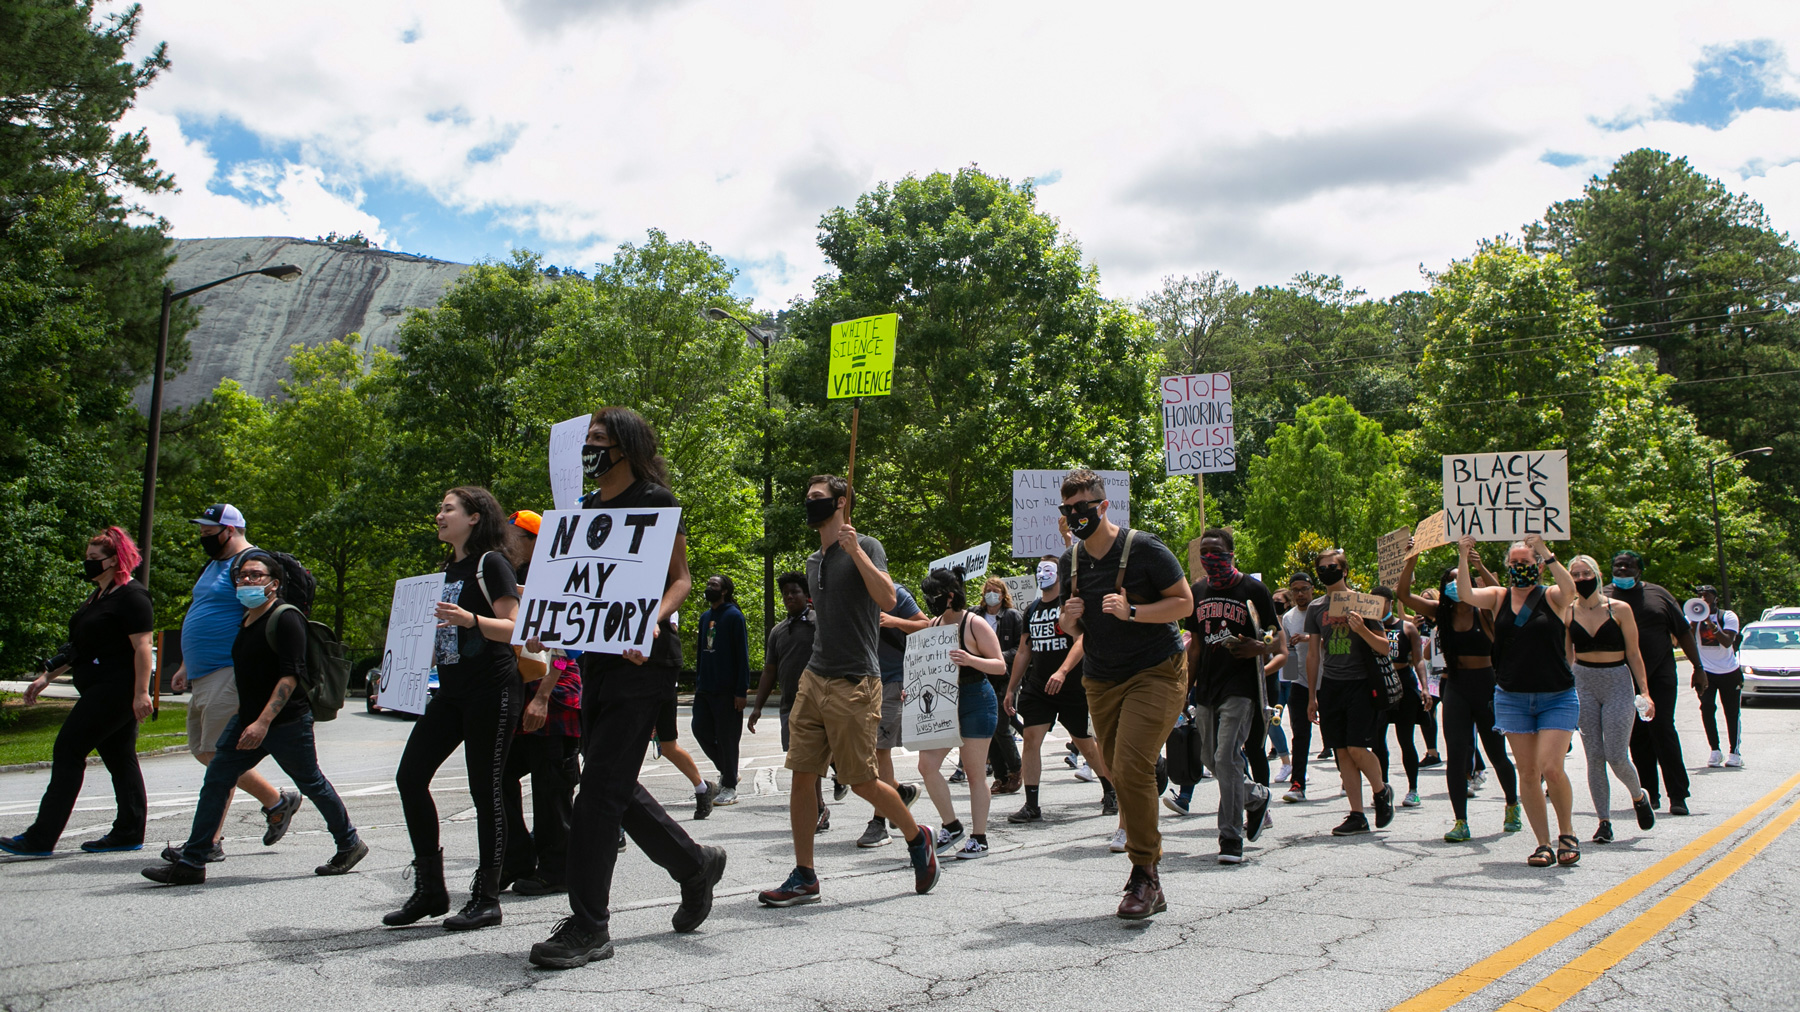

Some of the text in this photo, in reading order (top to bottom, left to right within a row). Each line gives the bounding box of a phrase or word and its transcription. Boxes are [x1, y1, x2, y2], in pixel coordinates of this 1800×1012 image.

[841, 317, 883, 339] WHITE
[833, 339, 883, 358] SILENCE
[833, 370, 892, 396] VIOLENCE
[1163, 373, 1231, 404] STOP
[1165, 401, 1232, 428] HONORING
[1166, 427, 1233, 452] RACIST
[1168, 447, 1235, 472] LOSERS
[1452, 453, 1548, 483] BLACK
[1018, 473, 1047, 489] ALL
[1104, 477, 1129, 487] TUDIED
[1015, 497, 1130, 512] NOT ALL ONORED
[1457, 481, 1547, 508] LIVES
[1014, 515, 1038, 531] CSA
[1446, 506, 1564, 537] MATTER
[549, 512, 660, 559] NOT
[1017, 534, 1042, 555] JIM
[1378, 534, 1395, 547] DEAR
[1378, 542, 1400, 555] WHITE
[966, 552, 988, 574] Matter
[563, 561, 617, 598] MY
[390, 580, 439, 631] SHAVE
[1333, 593, 1351, 602] Black
[520, 598, 659, 646] HISTORY
[1031, 623, 1054, 636] IVES
[396, 625, 424, 671] IT
[907, 635, 917, 651] All
[925, 650, 947, 662] until
[944, 663, 957, 673] do
[397, 667, 429, 710] OFF!
